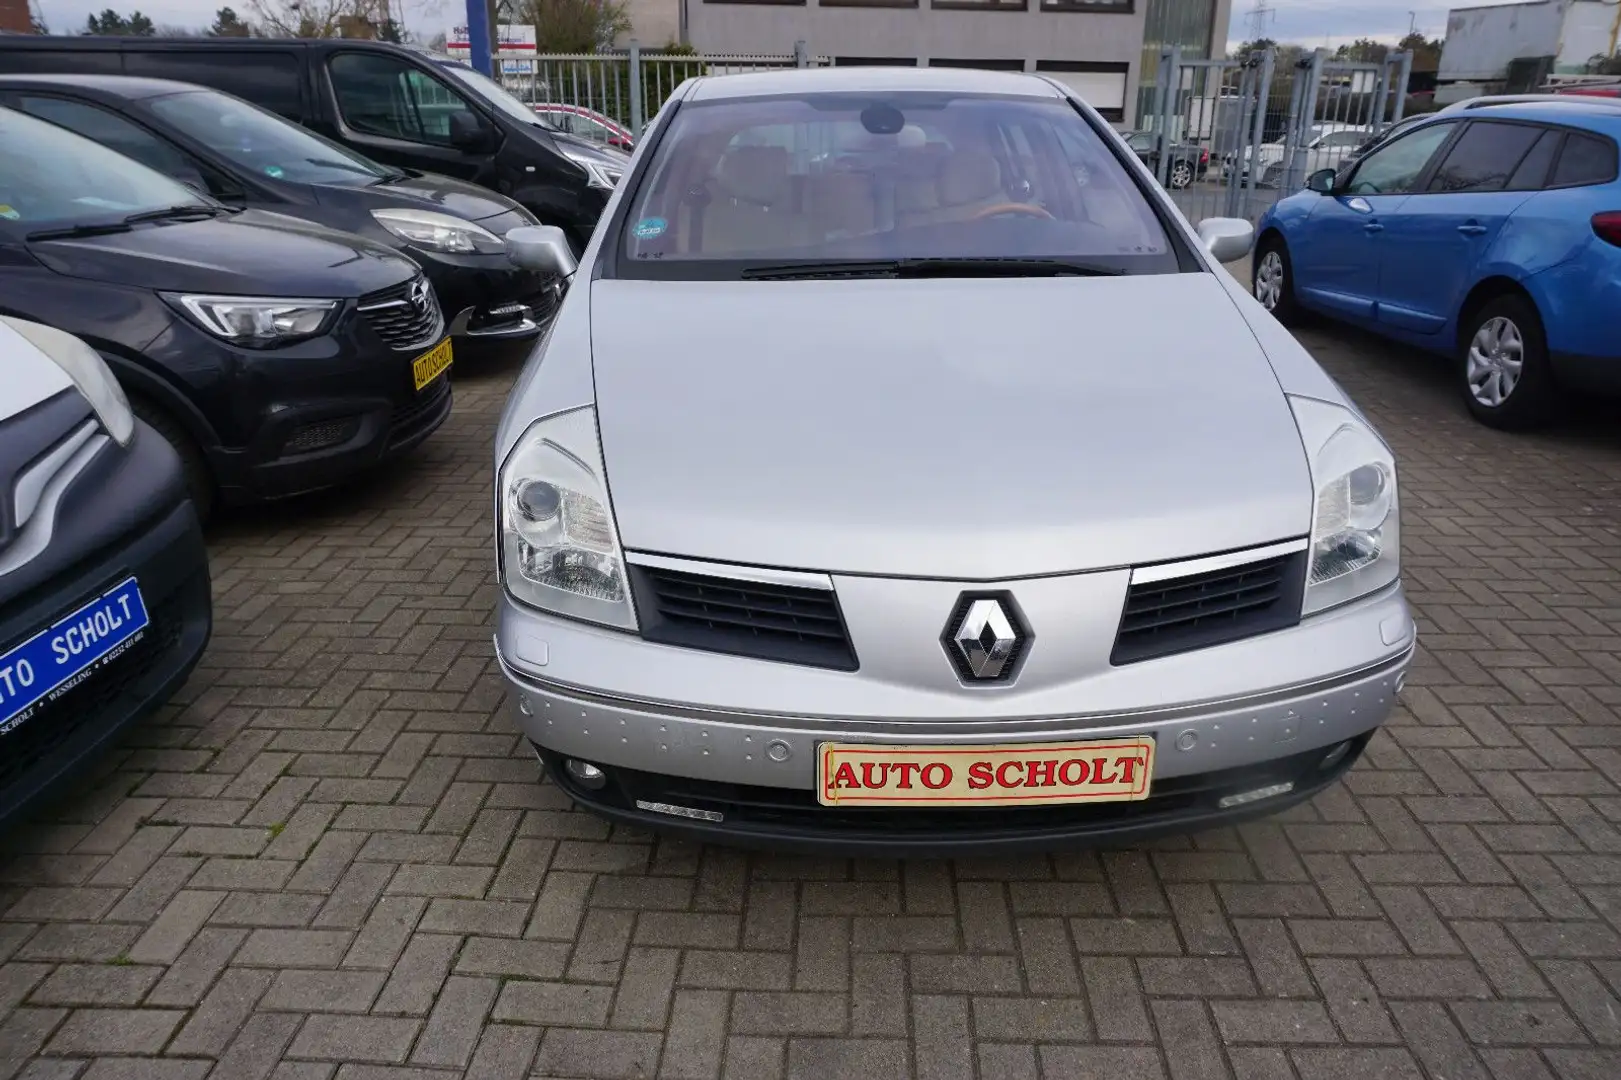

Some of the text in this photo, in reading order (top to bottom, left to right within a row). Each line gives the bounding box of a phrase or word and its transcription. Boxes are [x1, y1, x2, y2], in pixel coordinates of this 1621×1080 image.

[416, 357, 432, 382] AUTO
[0, 593, 132, 704] TO SCHOLT
[0, 708, 33, 735] SCHOLT
[48, 668, 92, 701] WESSELING
[827, 756, 1145, 790] AUTO SCHOLT
